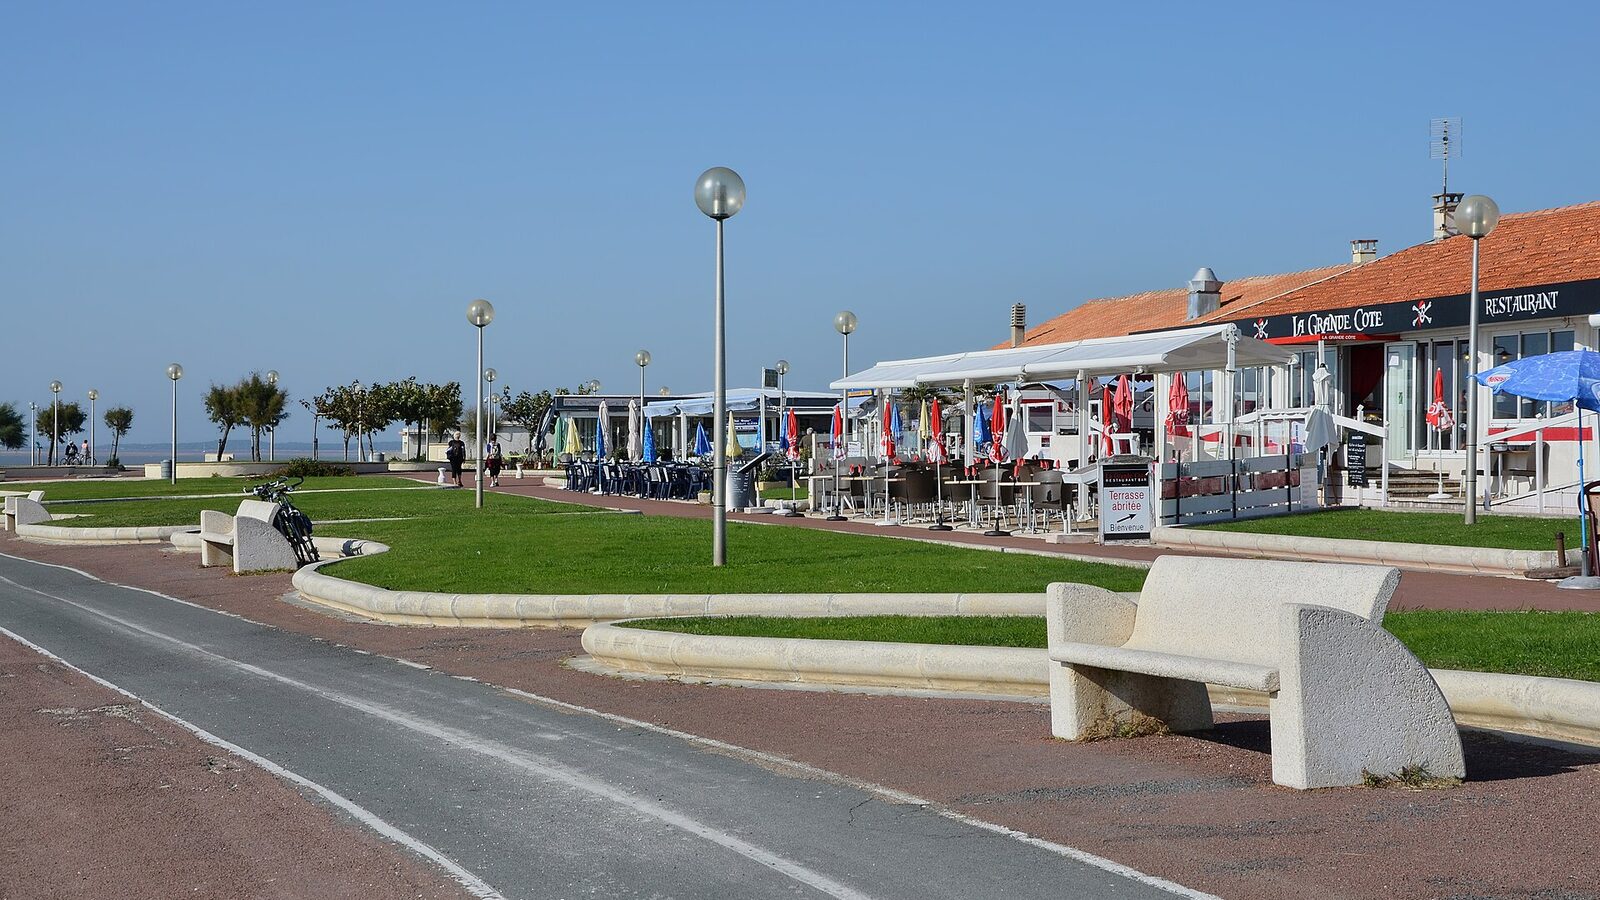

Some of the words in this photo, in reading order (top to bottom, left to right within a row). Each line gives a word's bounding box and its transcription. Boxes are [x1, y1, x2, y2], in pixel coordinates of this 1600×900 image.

[1485, 291, 1558, 317] RESTAURANT
[1292, 315, 1304, 337] LA
[1308, 313, 1351, 336] GRANDE
[1354, 308, 1383, 331] COTE
[1109, 491, 1144, 500] Terrasse
[1112, 501, 1141, 511] abritée
[1110, 523, 1144, 532] Bienvenue
